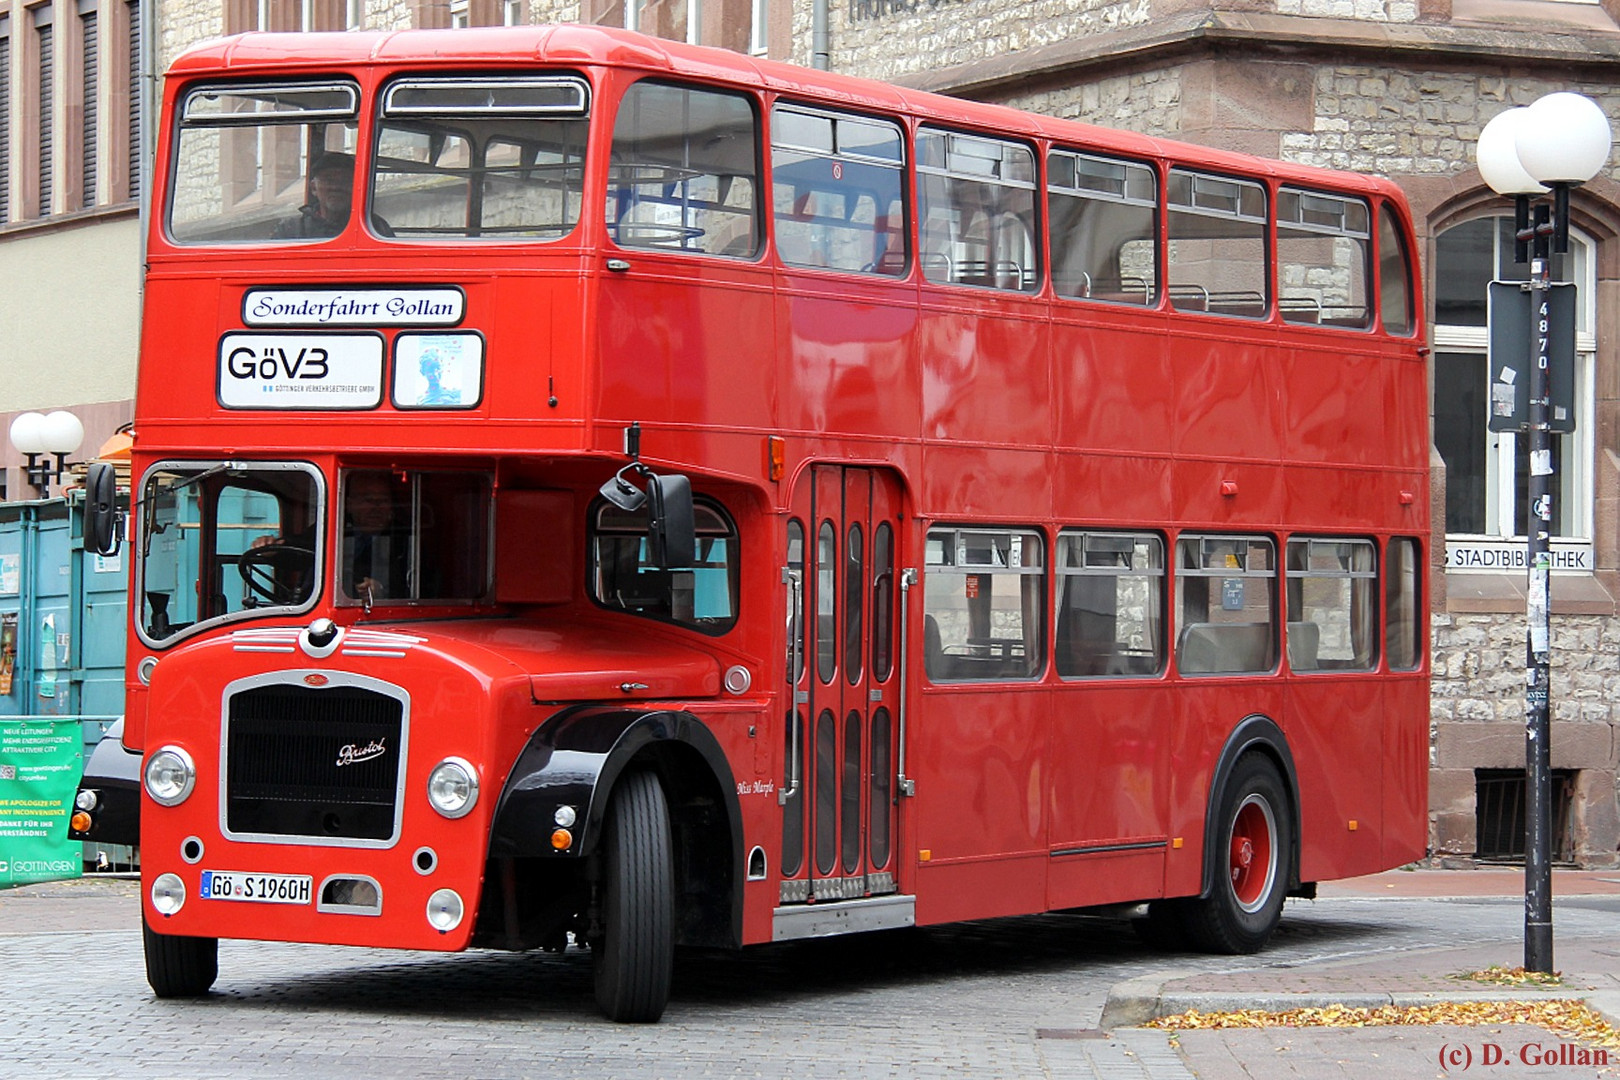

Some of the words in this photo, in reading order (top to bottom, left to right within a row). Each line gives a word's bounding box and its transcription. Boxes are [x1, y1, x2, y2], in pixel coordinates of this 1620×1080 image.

[253, 296, 380, 322] Sonderfahrt
[386, 298, 453, 317] Gollan
[1538, 302, 1548, 369] 4870
[275, 385, 304, 393] GÖTTINGER
[305, 385, 358, 393] VERKEHRSBETRIEBE
[336, 737, 386, 767] Bristol
[737, 780, 752, 795] Miss
[753, 778, 774, 798] Marple
[10, 799, 48, 807] APOLOGIZE
[0, 820, 22, 828] DANKE
[24, 819, 39, 828] FÜR
[212, 875, 233, 896] GÖ
